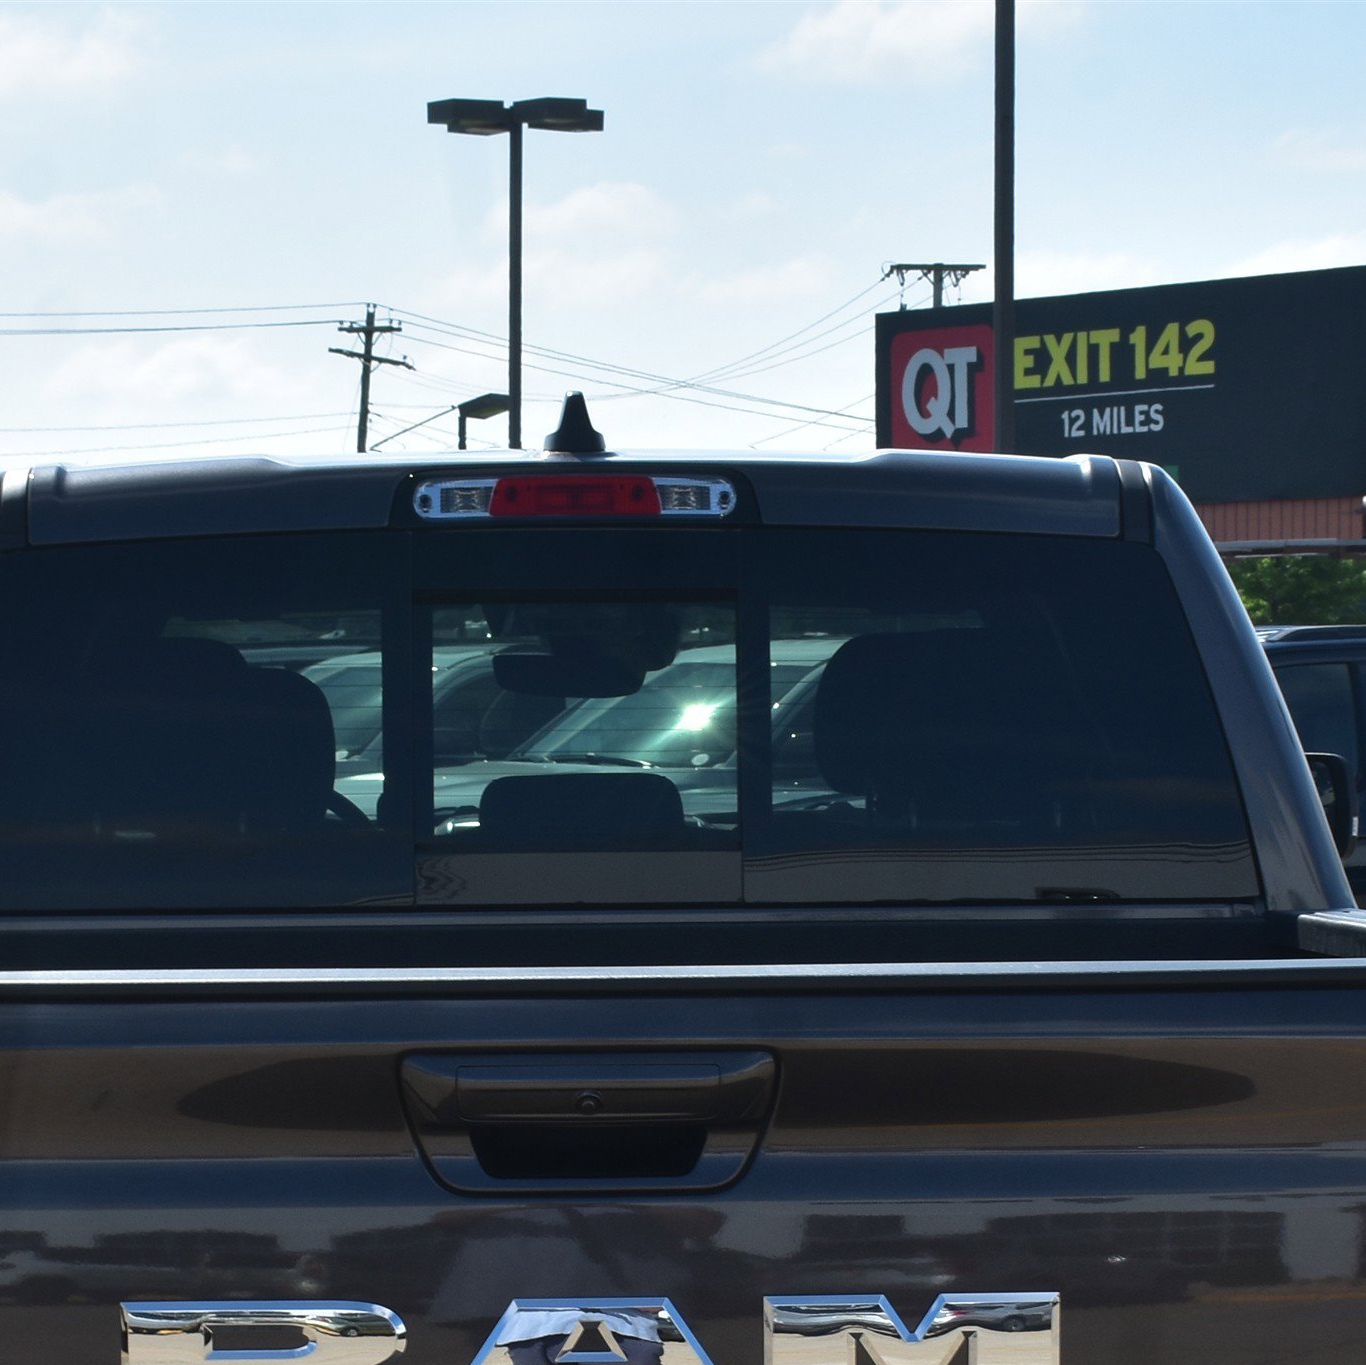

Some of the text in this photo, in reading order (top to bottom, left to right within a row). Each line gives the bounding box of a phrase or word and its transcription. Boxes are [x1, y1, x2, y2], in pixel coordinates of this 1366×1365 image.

[1014, 319, 1215, 390] EXIT 142
[902, 346, 977, 439] QT
[1062, 403, 1164, 438] 12 MILES
